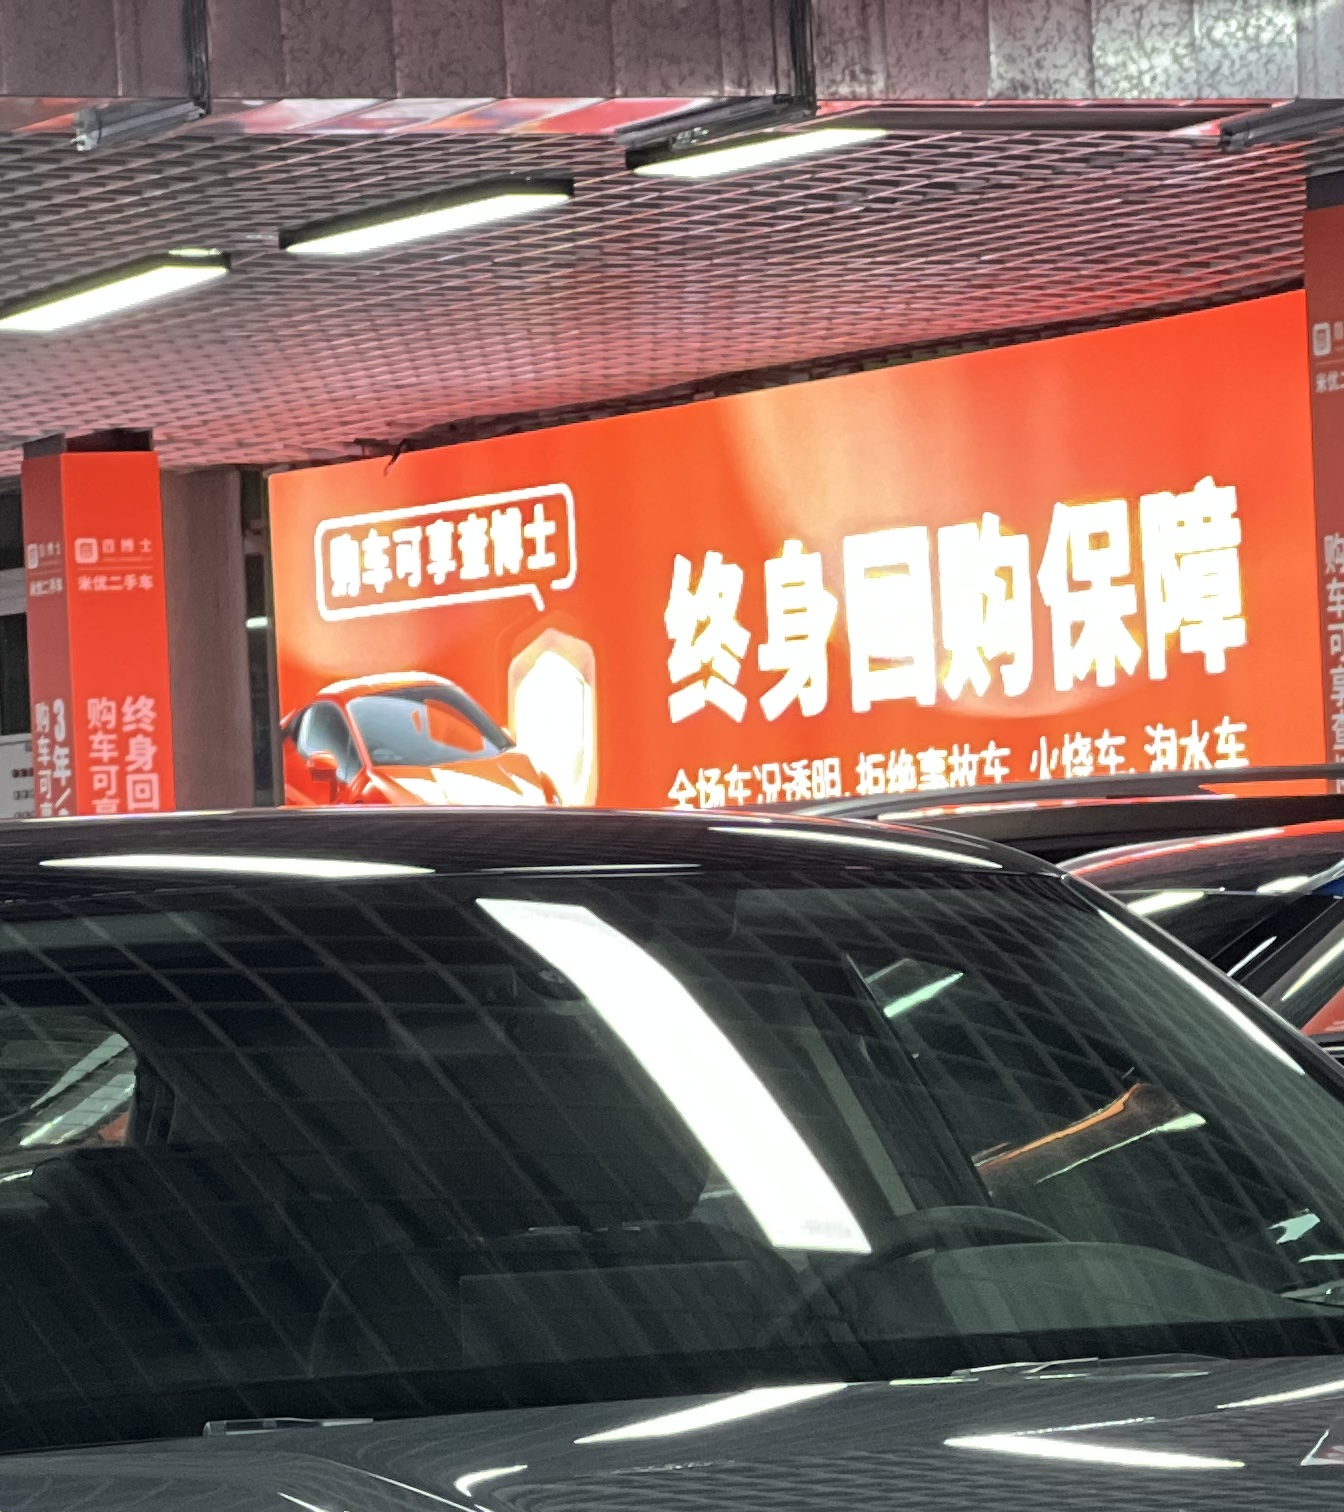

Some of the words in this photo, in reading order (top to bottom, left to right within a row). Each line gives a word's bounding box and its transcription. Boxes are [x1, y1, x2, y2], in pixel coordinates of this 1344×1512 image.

[664, 476, 1247, 724] 终身回购保障
